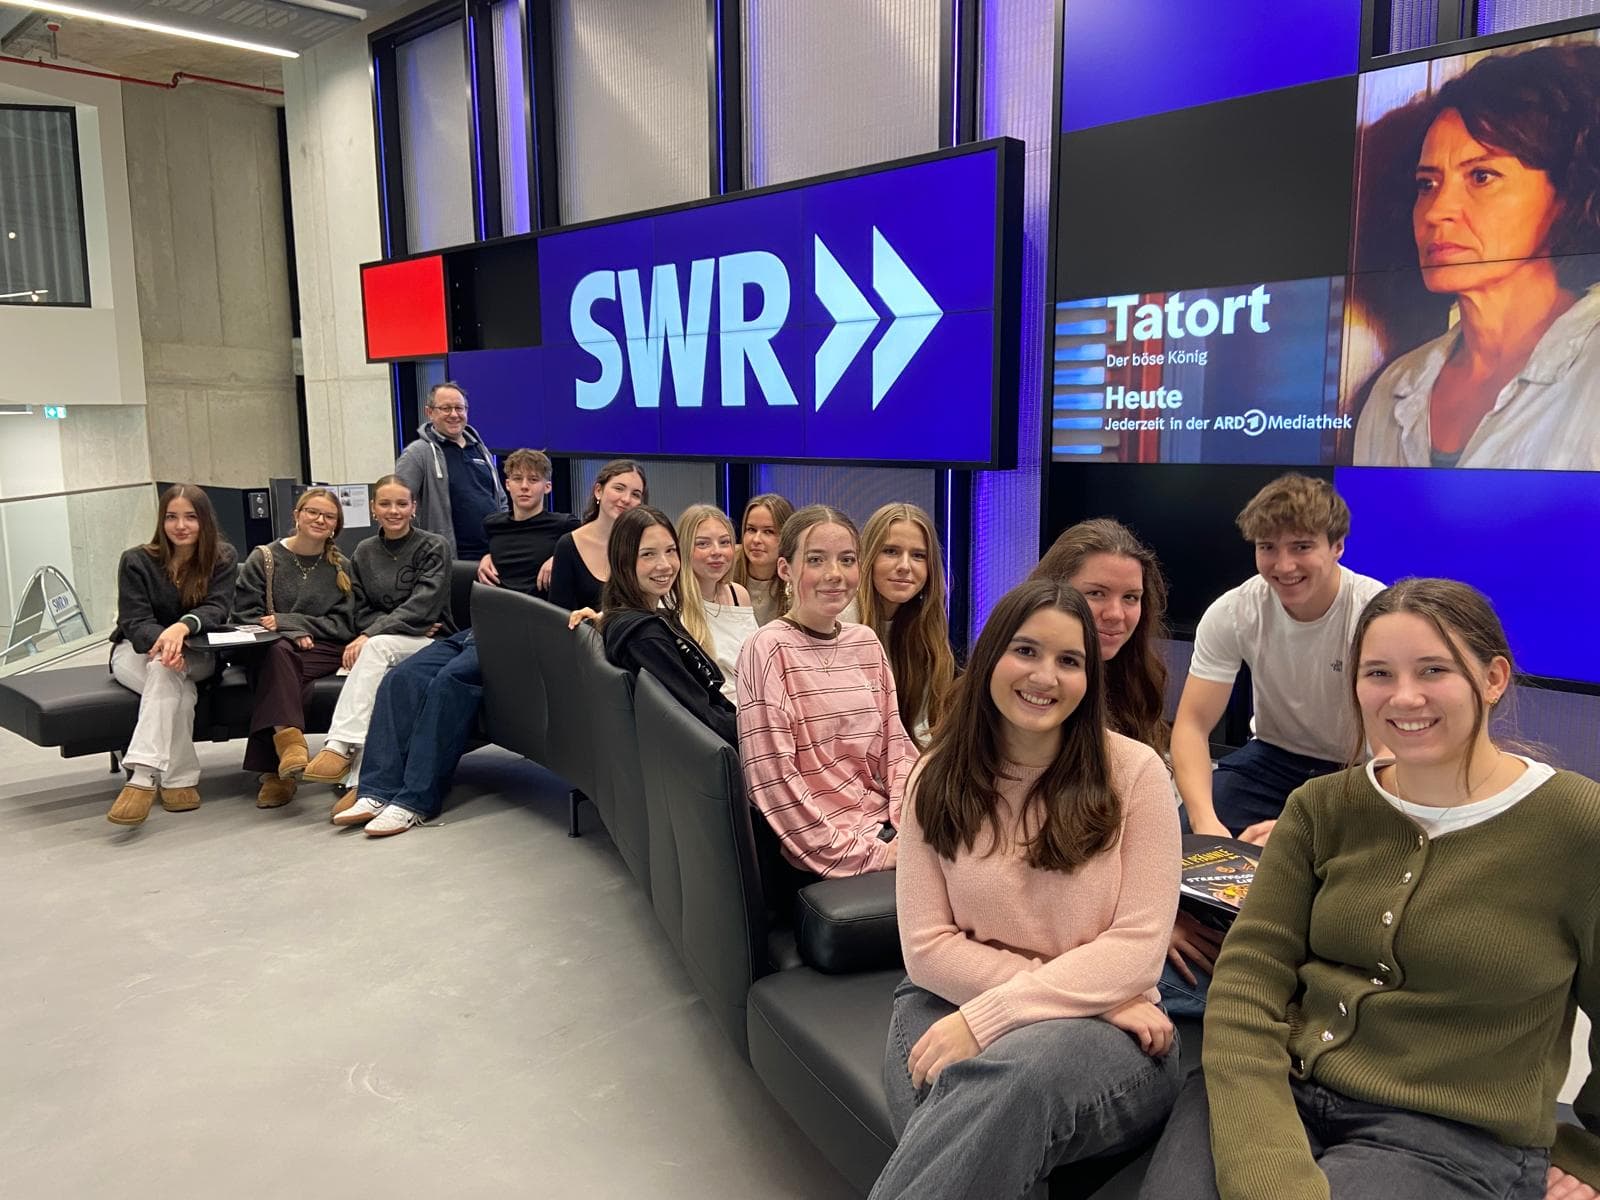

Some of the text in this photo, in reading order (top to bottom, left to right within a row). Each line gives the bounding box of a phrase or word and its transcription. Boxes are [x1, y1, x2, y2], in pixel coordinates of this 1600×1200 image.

[1106, 284, 1270, 342] Tatort
[570, 250, 799, 410] SWR
[1106, 350, 1208, 367] Der böse König
[1105, 386, 1183, 410] Heute
[1104, 417, 1165, 431] Jederzeit
[1169, 417, 1183, 430] in
[1186, 416, 1210, 430] der
[1213, 415, 1245, 430] ARD
[1267, 414, 1352, 430] Mediathek
